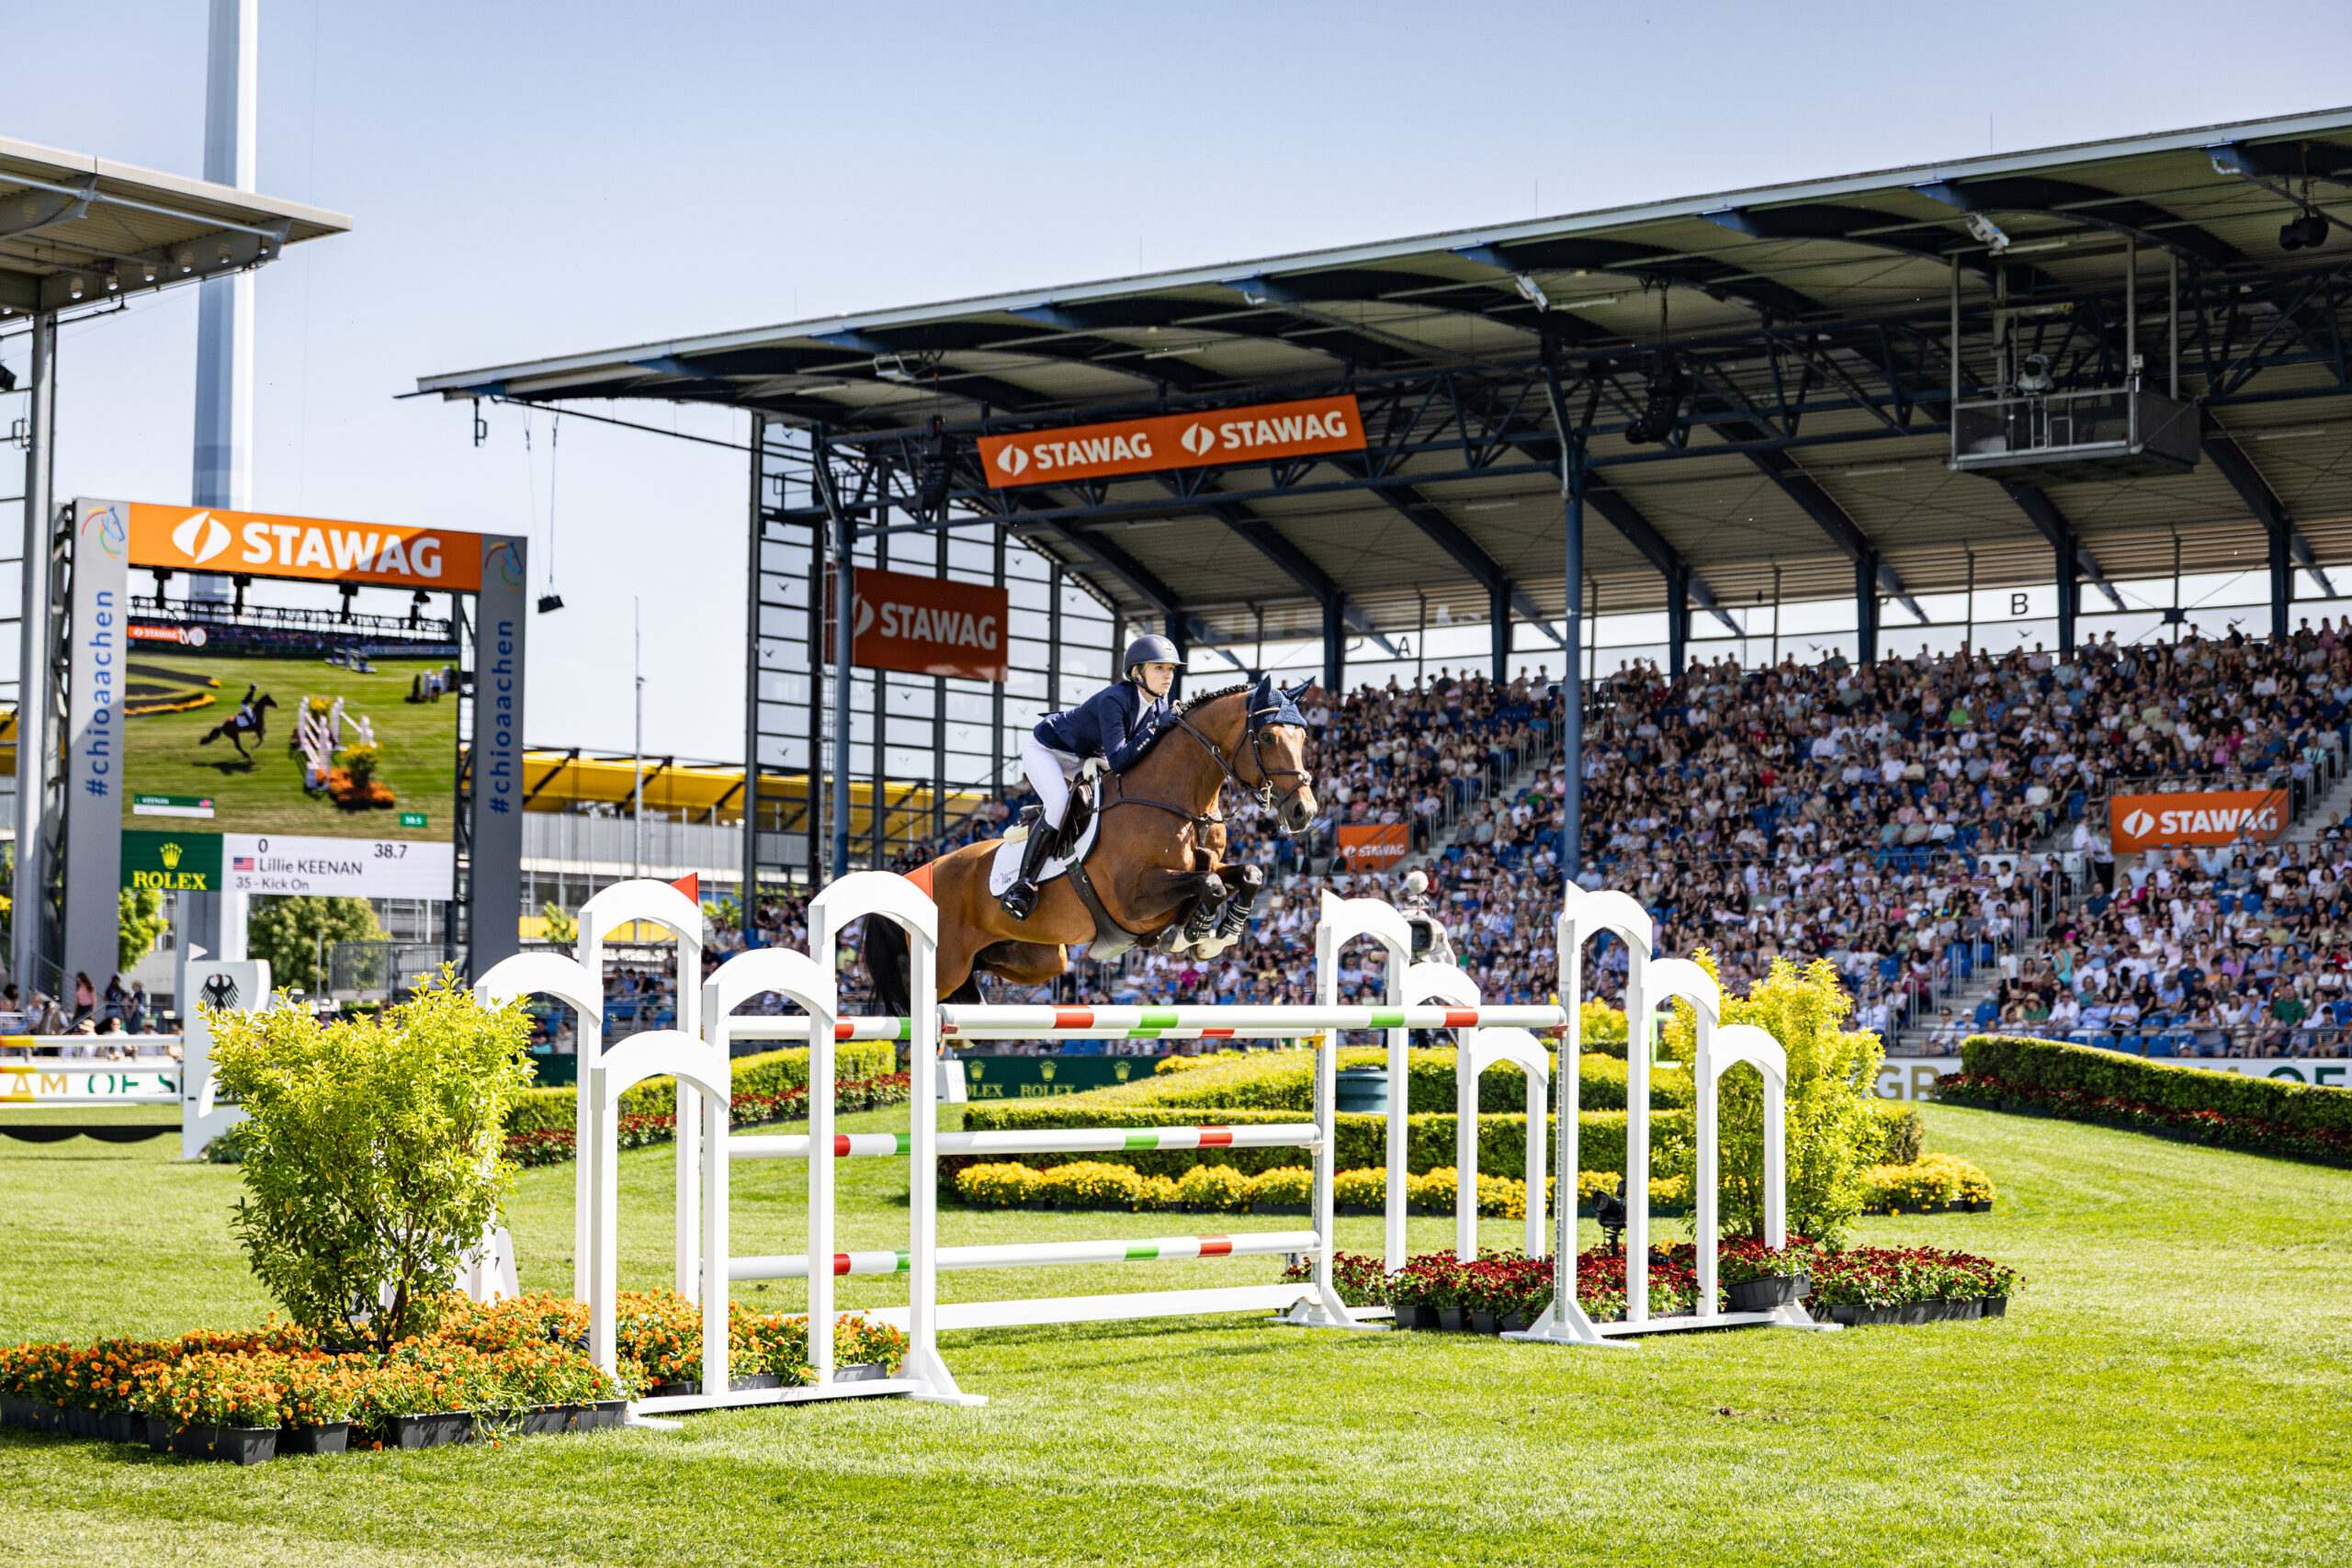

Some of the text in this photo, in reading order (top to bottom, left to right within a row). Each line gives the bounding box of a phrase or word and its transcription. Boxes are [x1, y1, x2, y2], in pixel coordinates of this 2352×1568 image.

[1219, 411, 1348, 449] STAWAG
[1033, 432, 1152, 470] STAWAG
[242, 522, 442, 578] STAWAG
[2010, 593, 2030, 616] B
[144, 629, 178, 639] STAWAG
[880, 602, 997, 650] STAWAG
[1396, 636, 1411, 657] A
[85, 591, 114, 797] #chioaachen
[489, 620, 514, 815] #chioaachen
[2160, 807, 2278, 835] STAWAG
[257, 838, 408, 860] 0 38.7
[1358, 843, 1406, 858] STAWAG
[259, 858, 363, 875] Lillie KEENAN
[132, 870, 208, 890] ROLEX
[236, 876, 251, 889] 35
[262, 877, 288, 890] Kick
[291, 879, 309, 891] On
